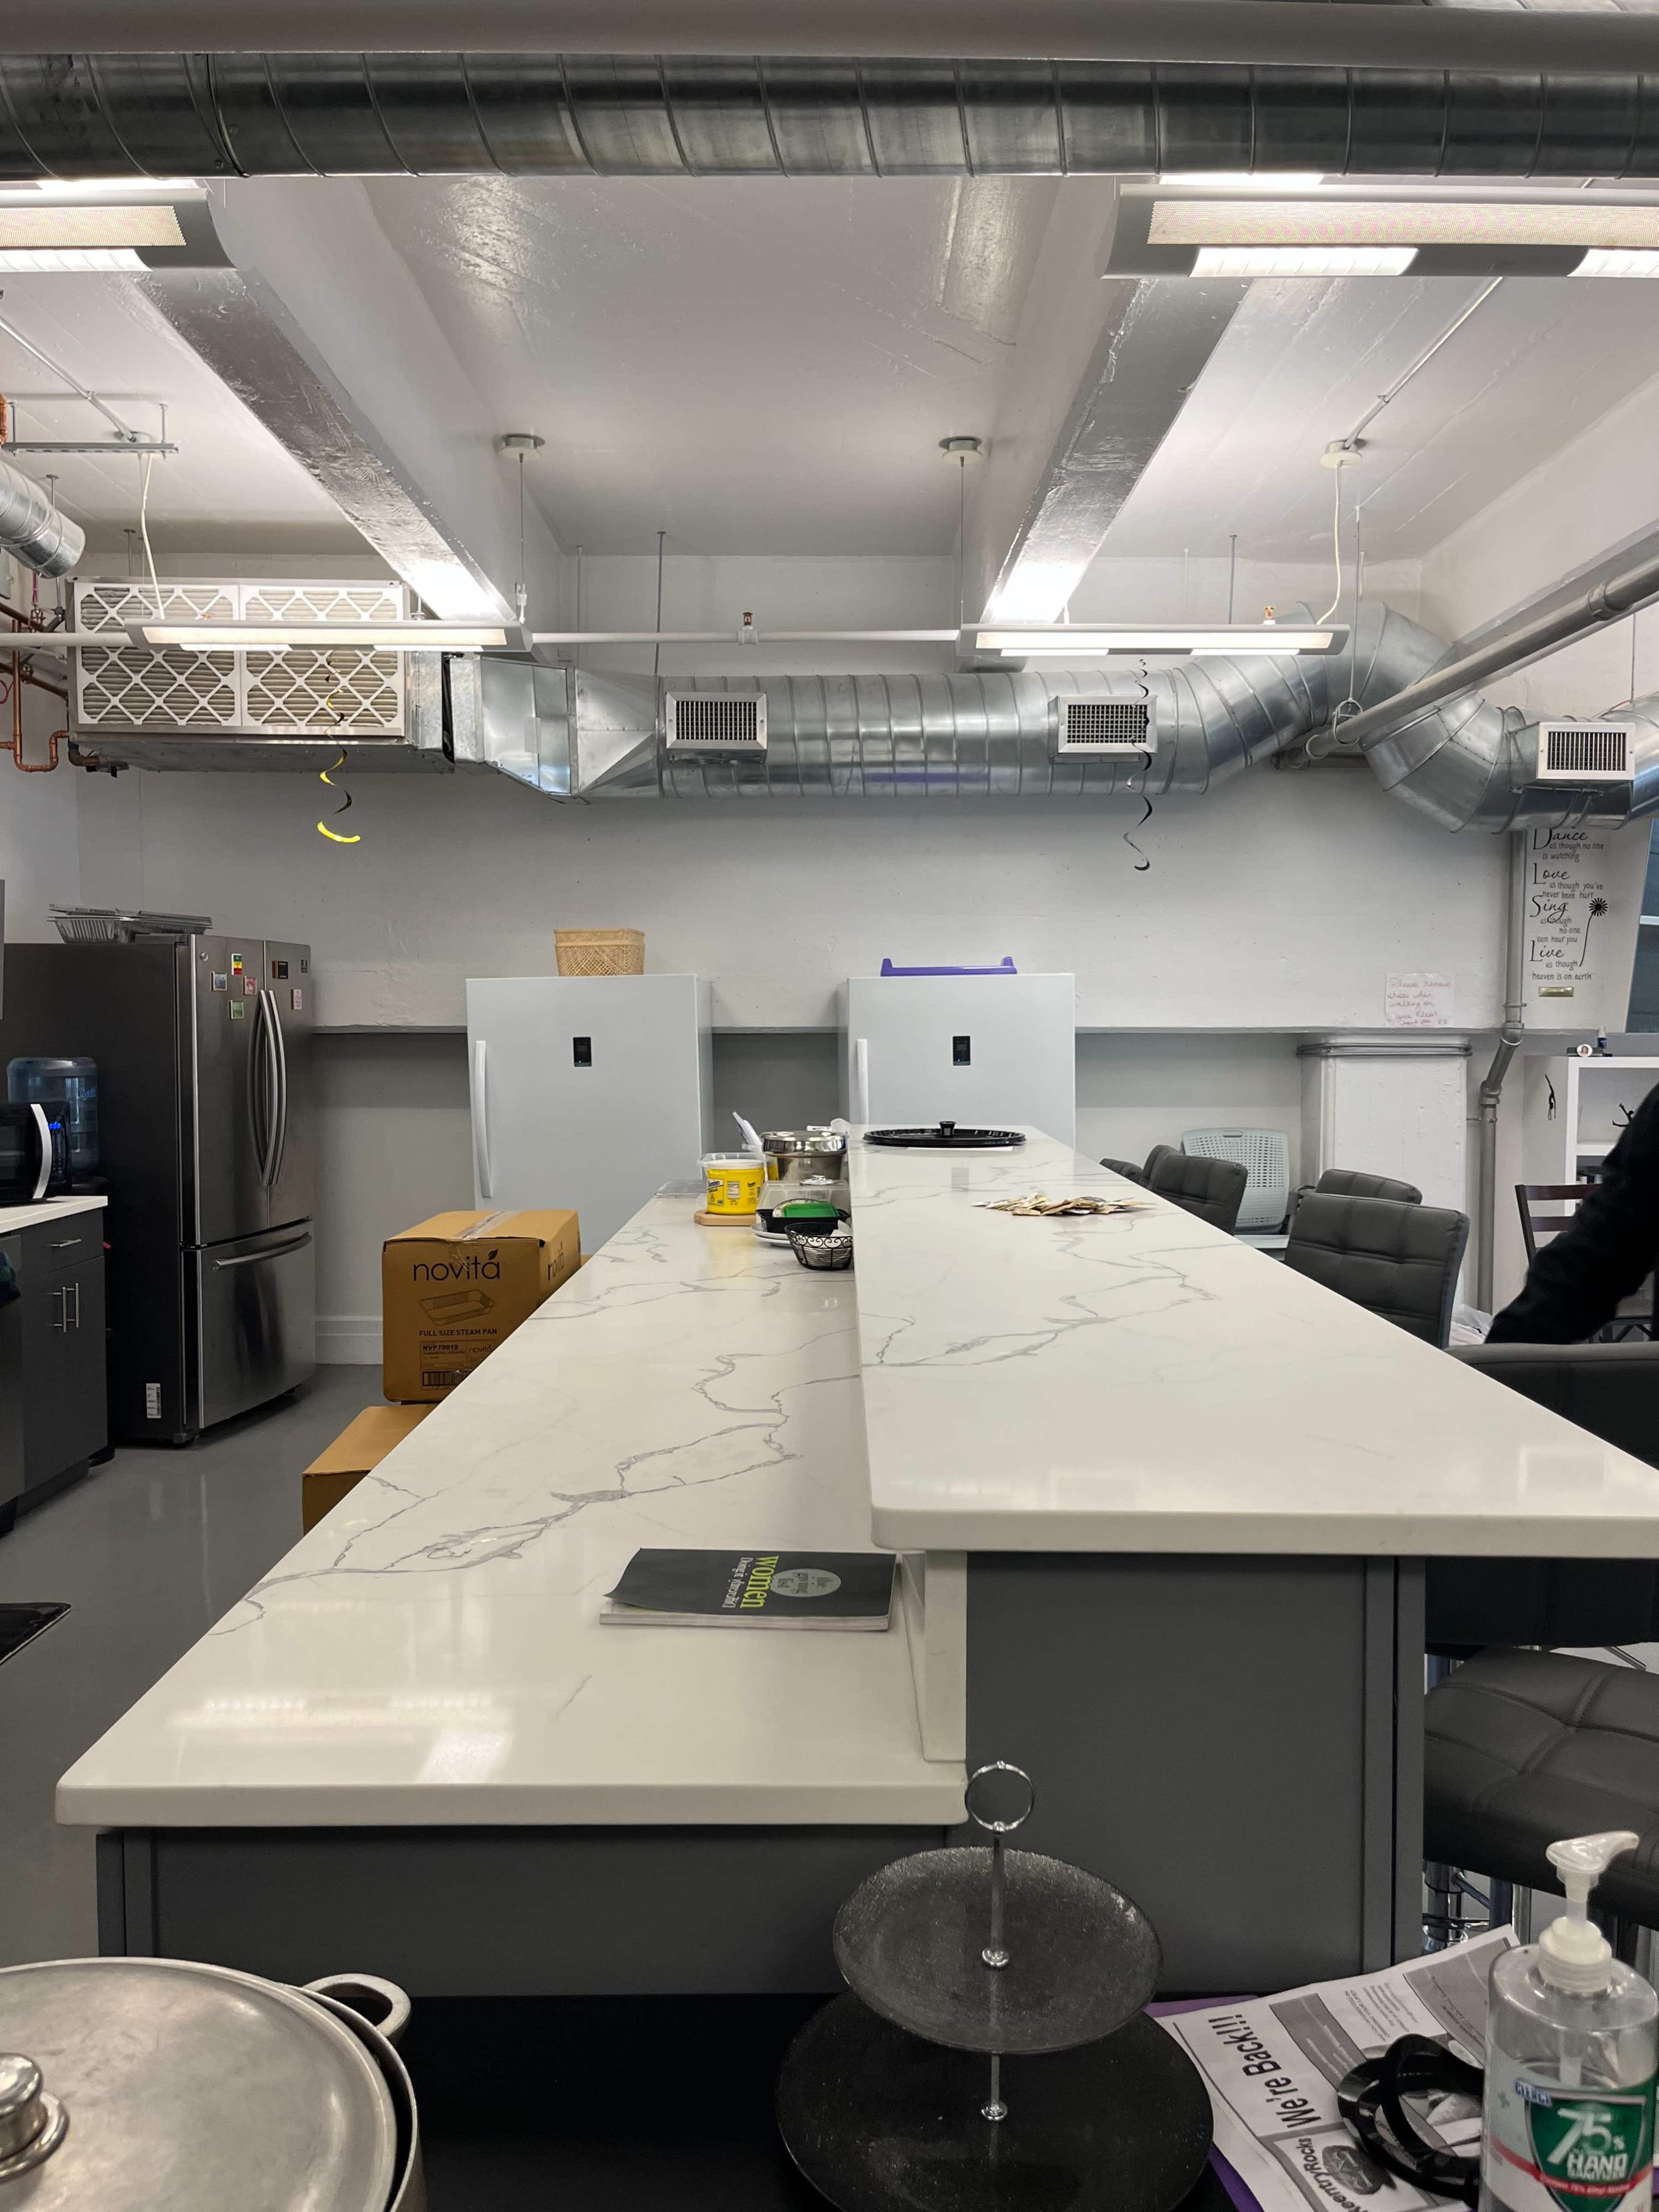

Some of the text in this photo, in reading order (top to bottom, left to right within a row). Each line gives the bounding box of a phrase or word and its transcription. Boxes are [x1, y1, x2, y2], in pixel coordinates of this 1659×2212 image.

[1533, 829, 1589, 850] Dance
[1559, 842, 1581, 853] though
[1550, 852, 1580, 863] watching
[1533, 863, 1570, 884] Love
[1557, 881, 1580, 893] though
[1583, 881, 1604, 892] you've
[1561, 891, 1576, 899] been
[1580, 891, 1594, 899] hurt
[1529, 895, 1569, 923] Sing
[1549, 915, 1572, 928] though
[1566, 937, 1578, 946] you
[1529, 940, 1565, 962] Live
[1555, 960, 1578, 971] though
[1532, 971, 1554, 980] heaven
[740, 1556, 779, 1608] women
[1208, 2014, 1322, 2129] We're Back!!!
